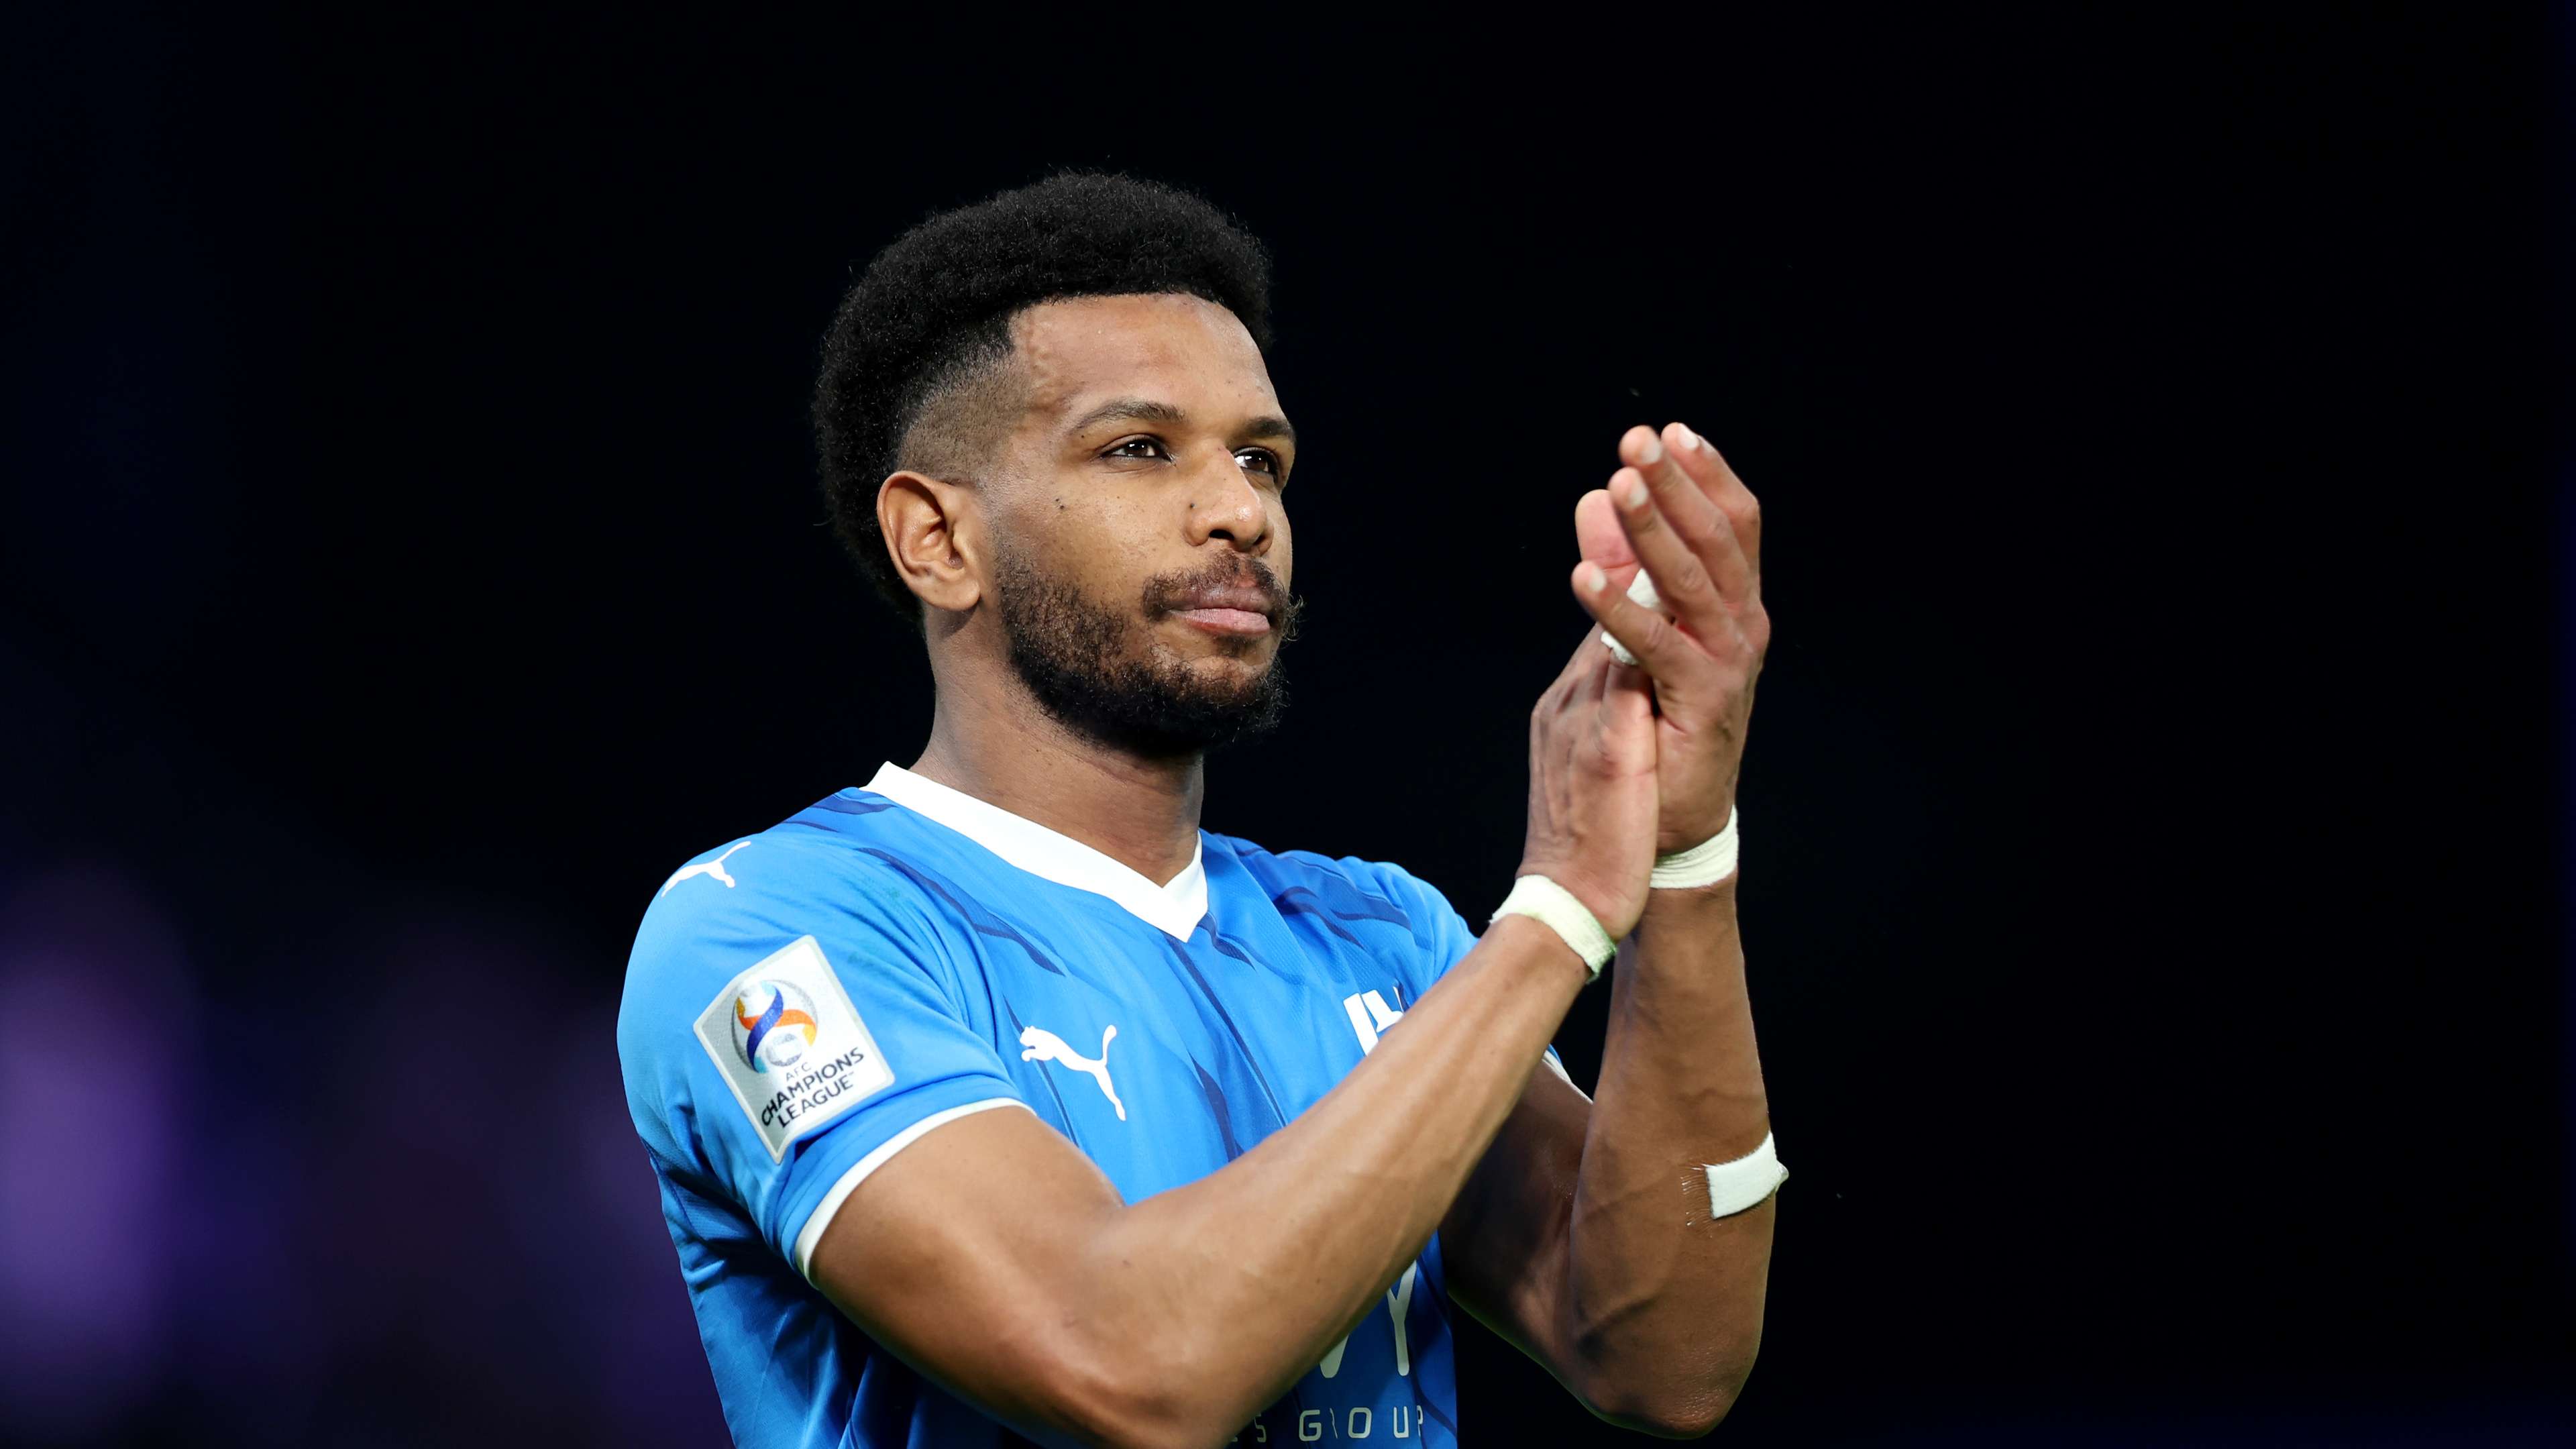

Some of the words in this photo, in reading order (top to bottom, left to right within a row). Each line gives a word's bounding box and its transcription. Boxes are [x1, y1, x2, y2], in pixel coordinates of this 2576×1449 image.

[761, 1046, 864, 1126] CHAMPIONS
[786, 1062, 812, 1081] AFC
[1299, 1405, 1424, 1442] GOUP
